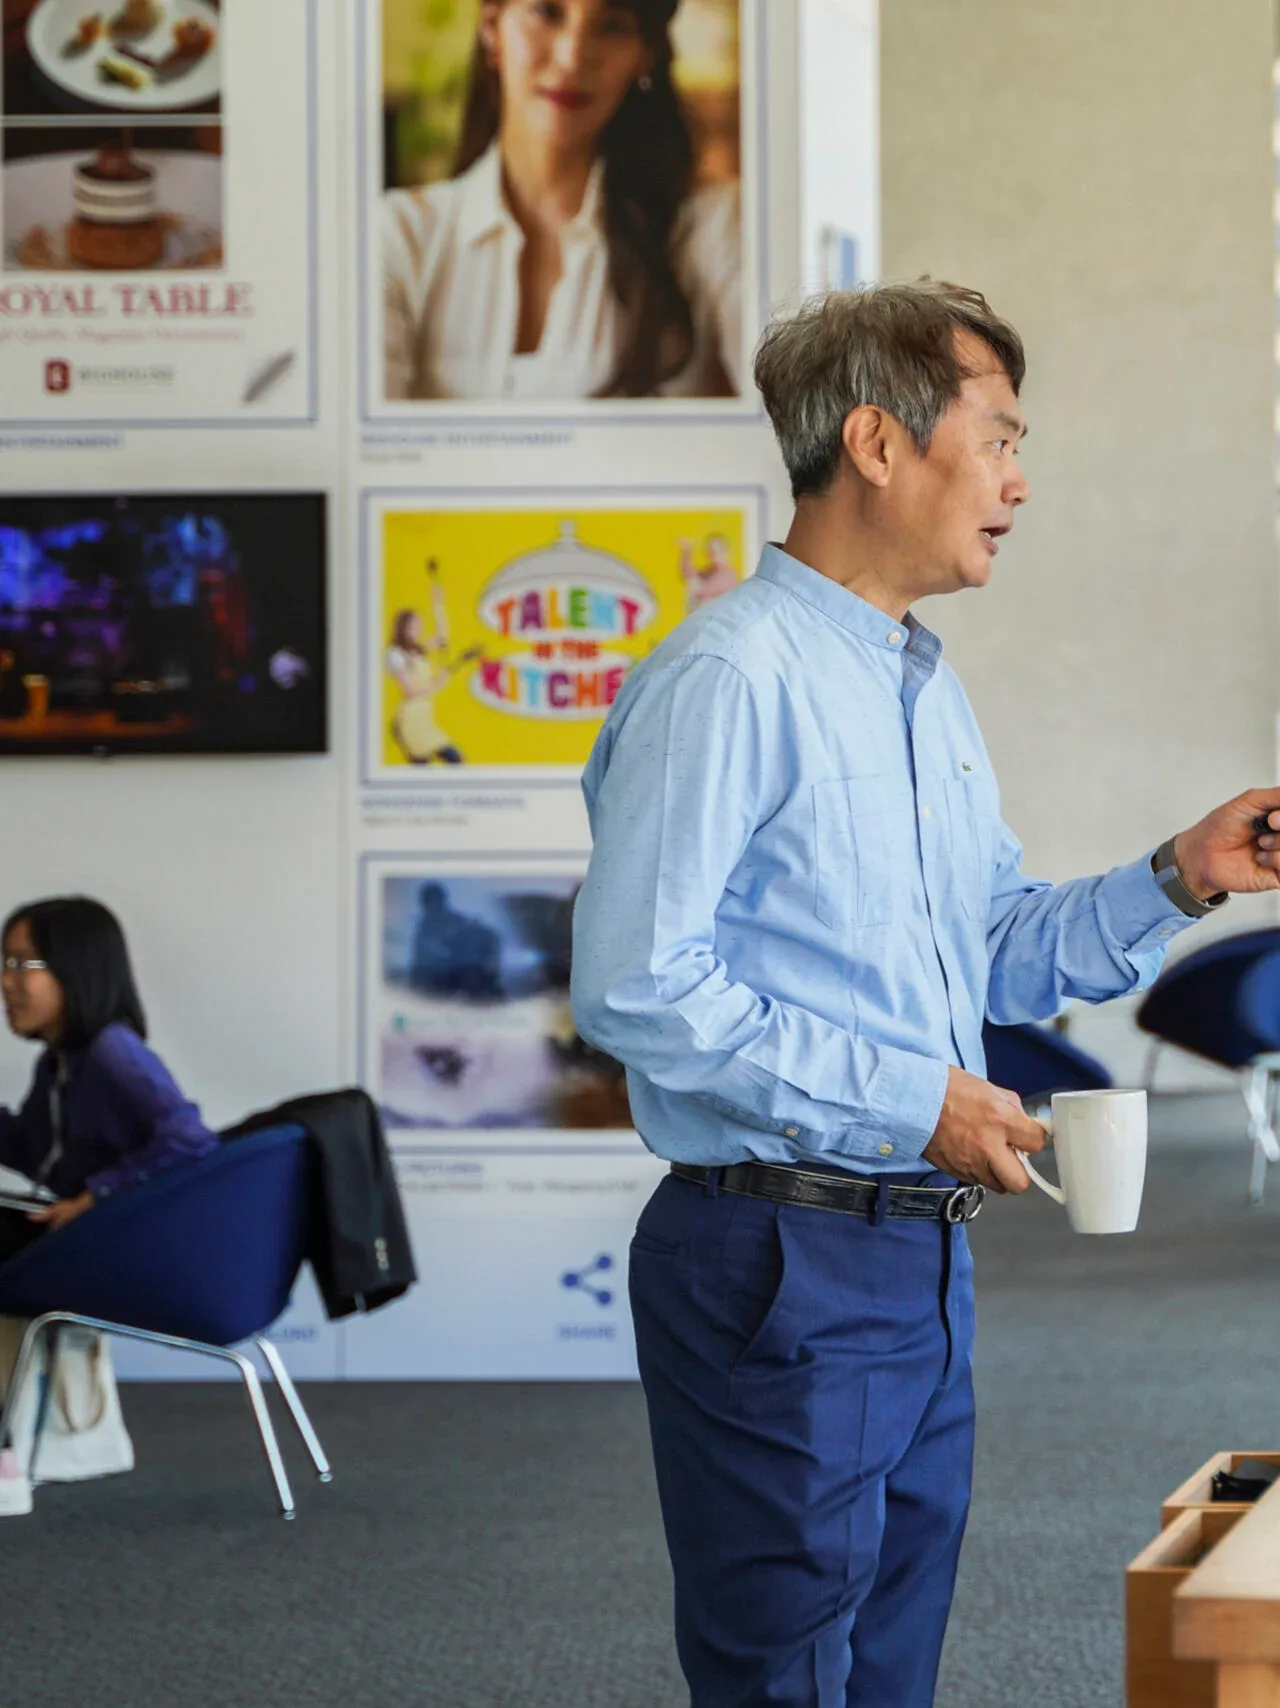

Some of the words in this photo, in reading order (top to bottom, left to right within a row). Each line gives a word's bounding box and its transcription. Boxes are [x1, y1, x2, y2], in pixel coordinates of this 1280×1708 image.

[0, 283, 107, 317] OYAL
[113, 283, 254, 317] TABLE
[494, 586, 641, 637] TALENT
[480, 656, 640, 710] KITCHE
